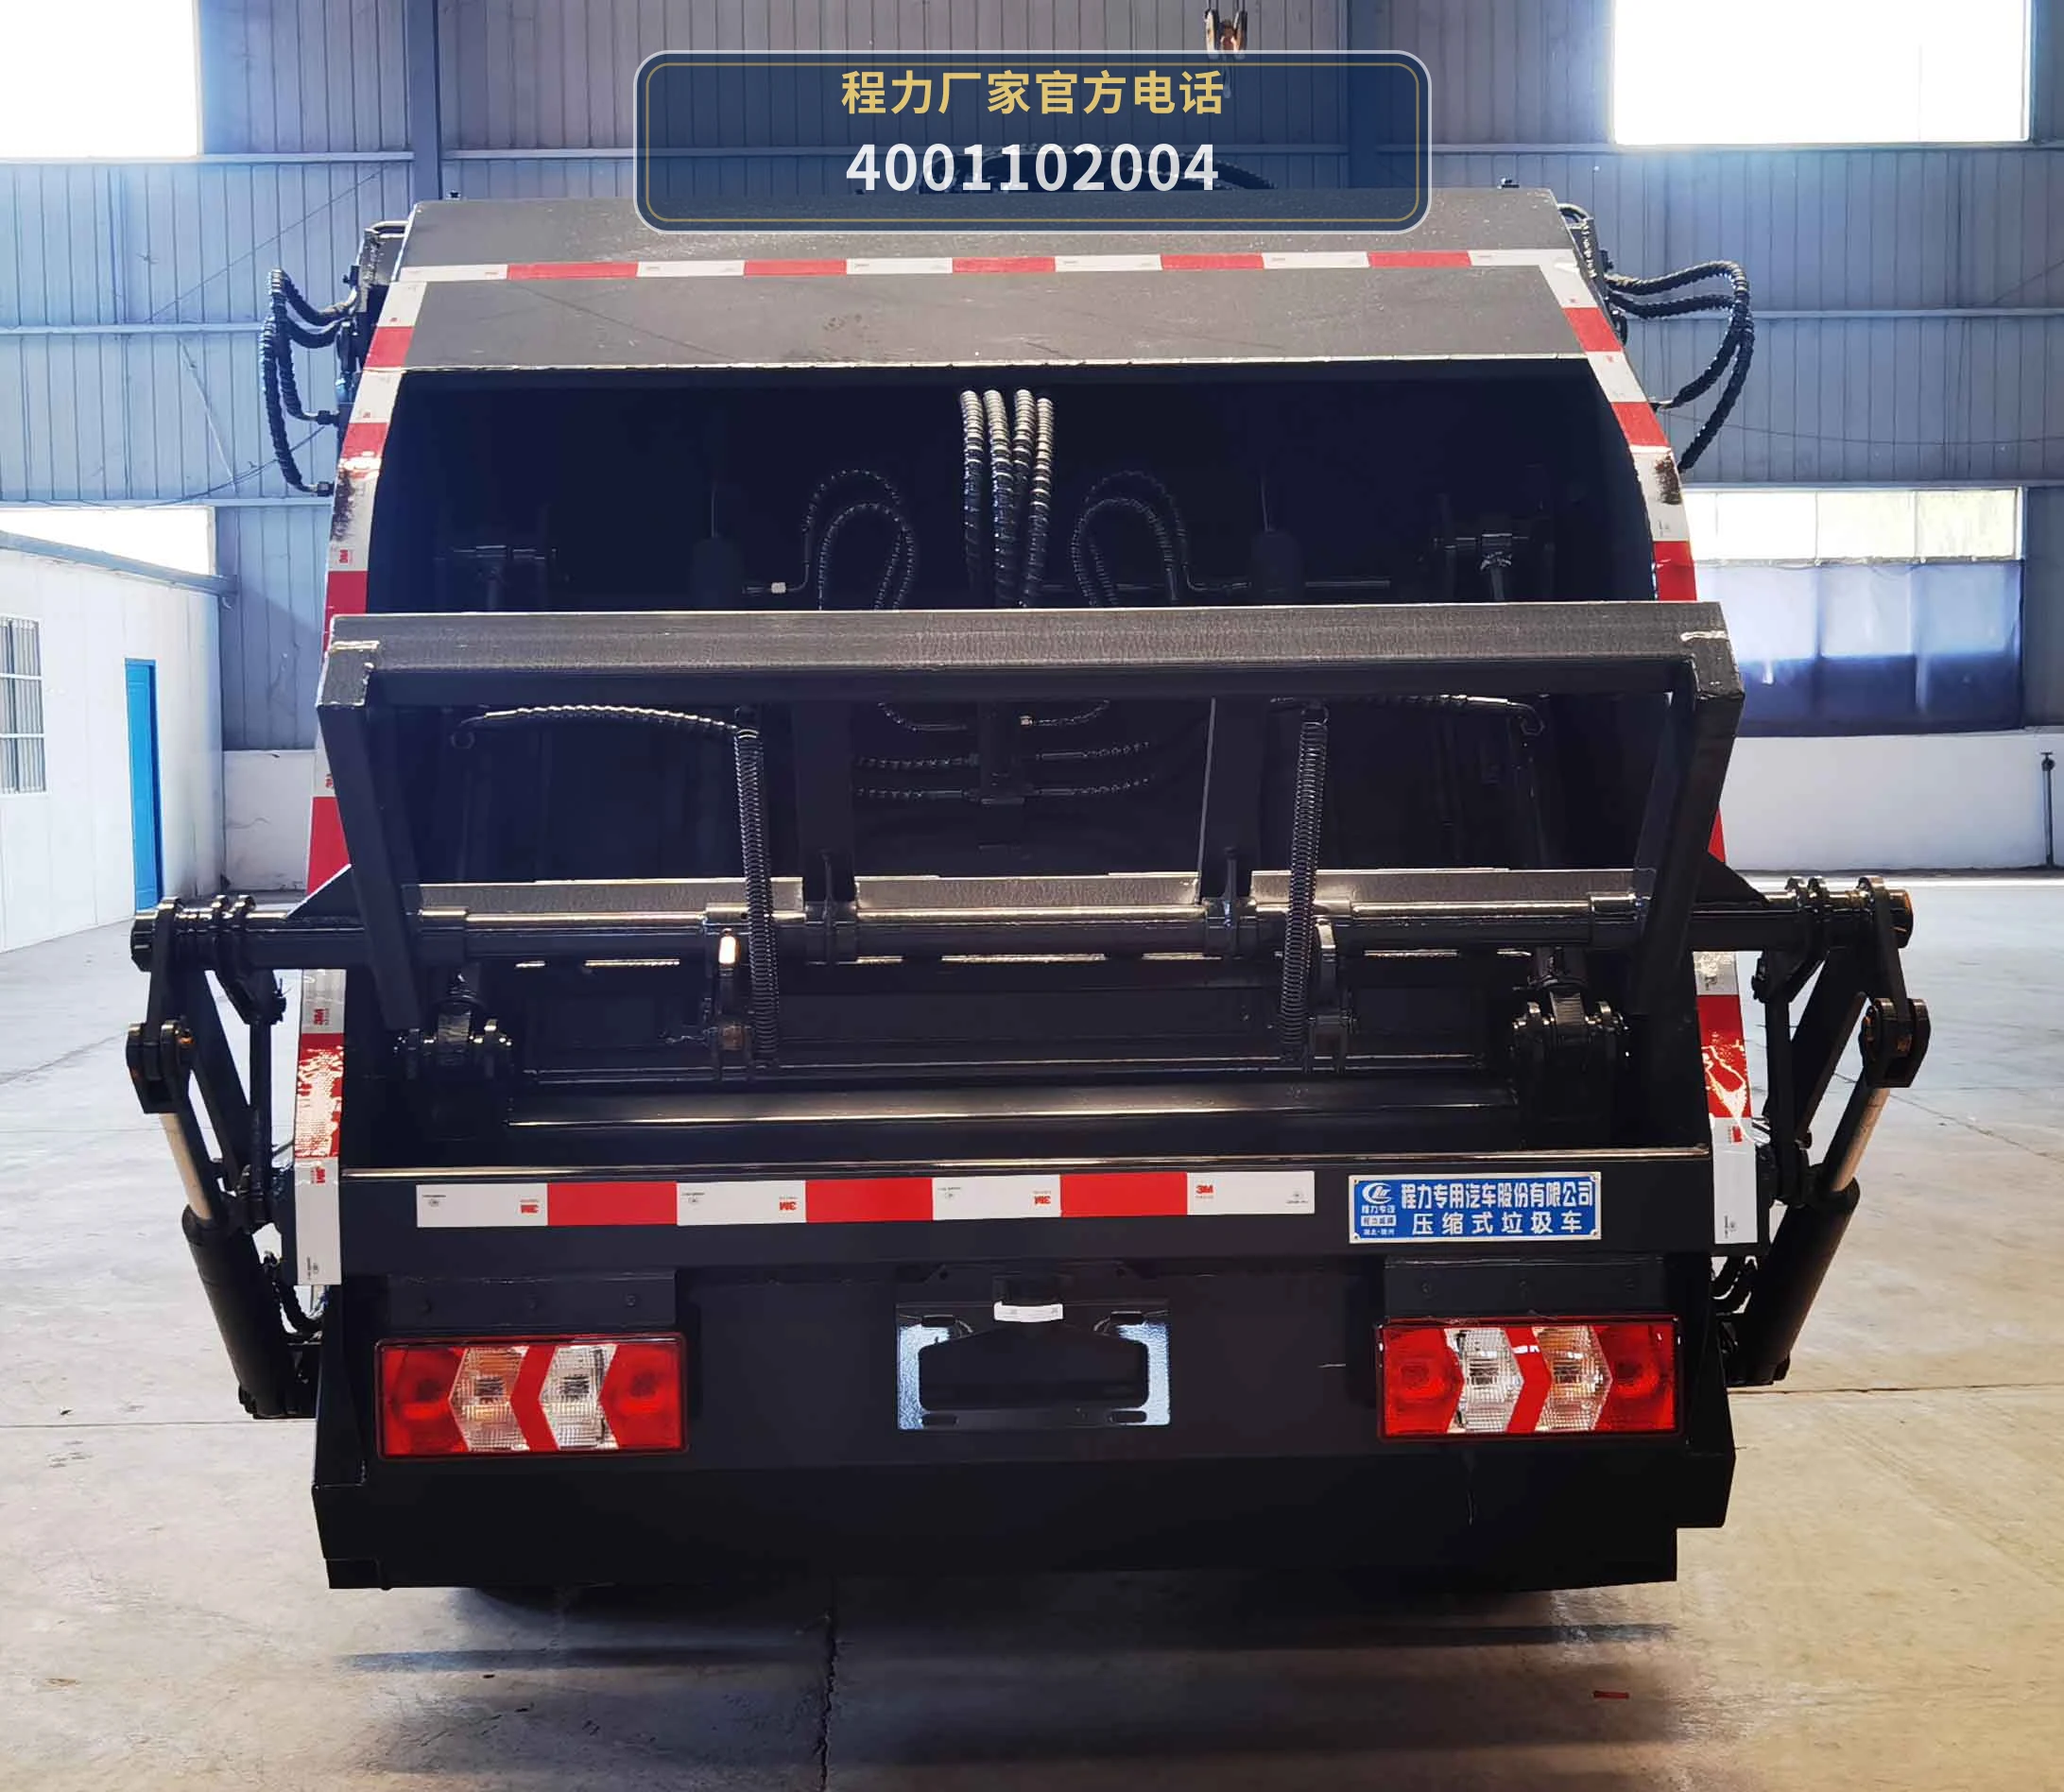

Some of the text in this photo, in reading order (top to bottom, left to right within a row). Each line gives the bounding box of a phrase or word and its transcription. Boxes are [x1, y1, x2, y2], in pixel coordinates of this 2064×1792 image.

[1195, 1184, 1213, 1194] 3M
[1402, 1181, 1593, 1210] 程力专用汽车股份有限公司
[1412, 1210, 1582, 1235] 压缩式垃圾车
